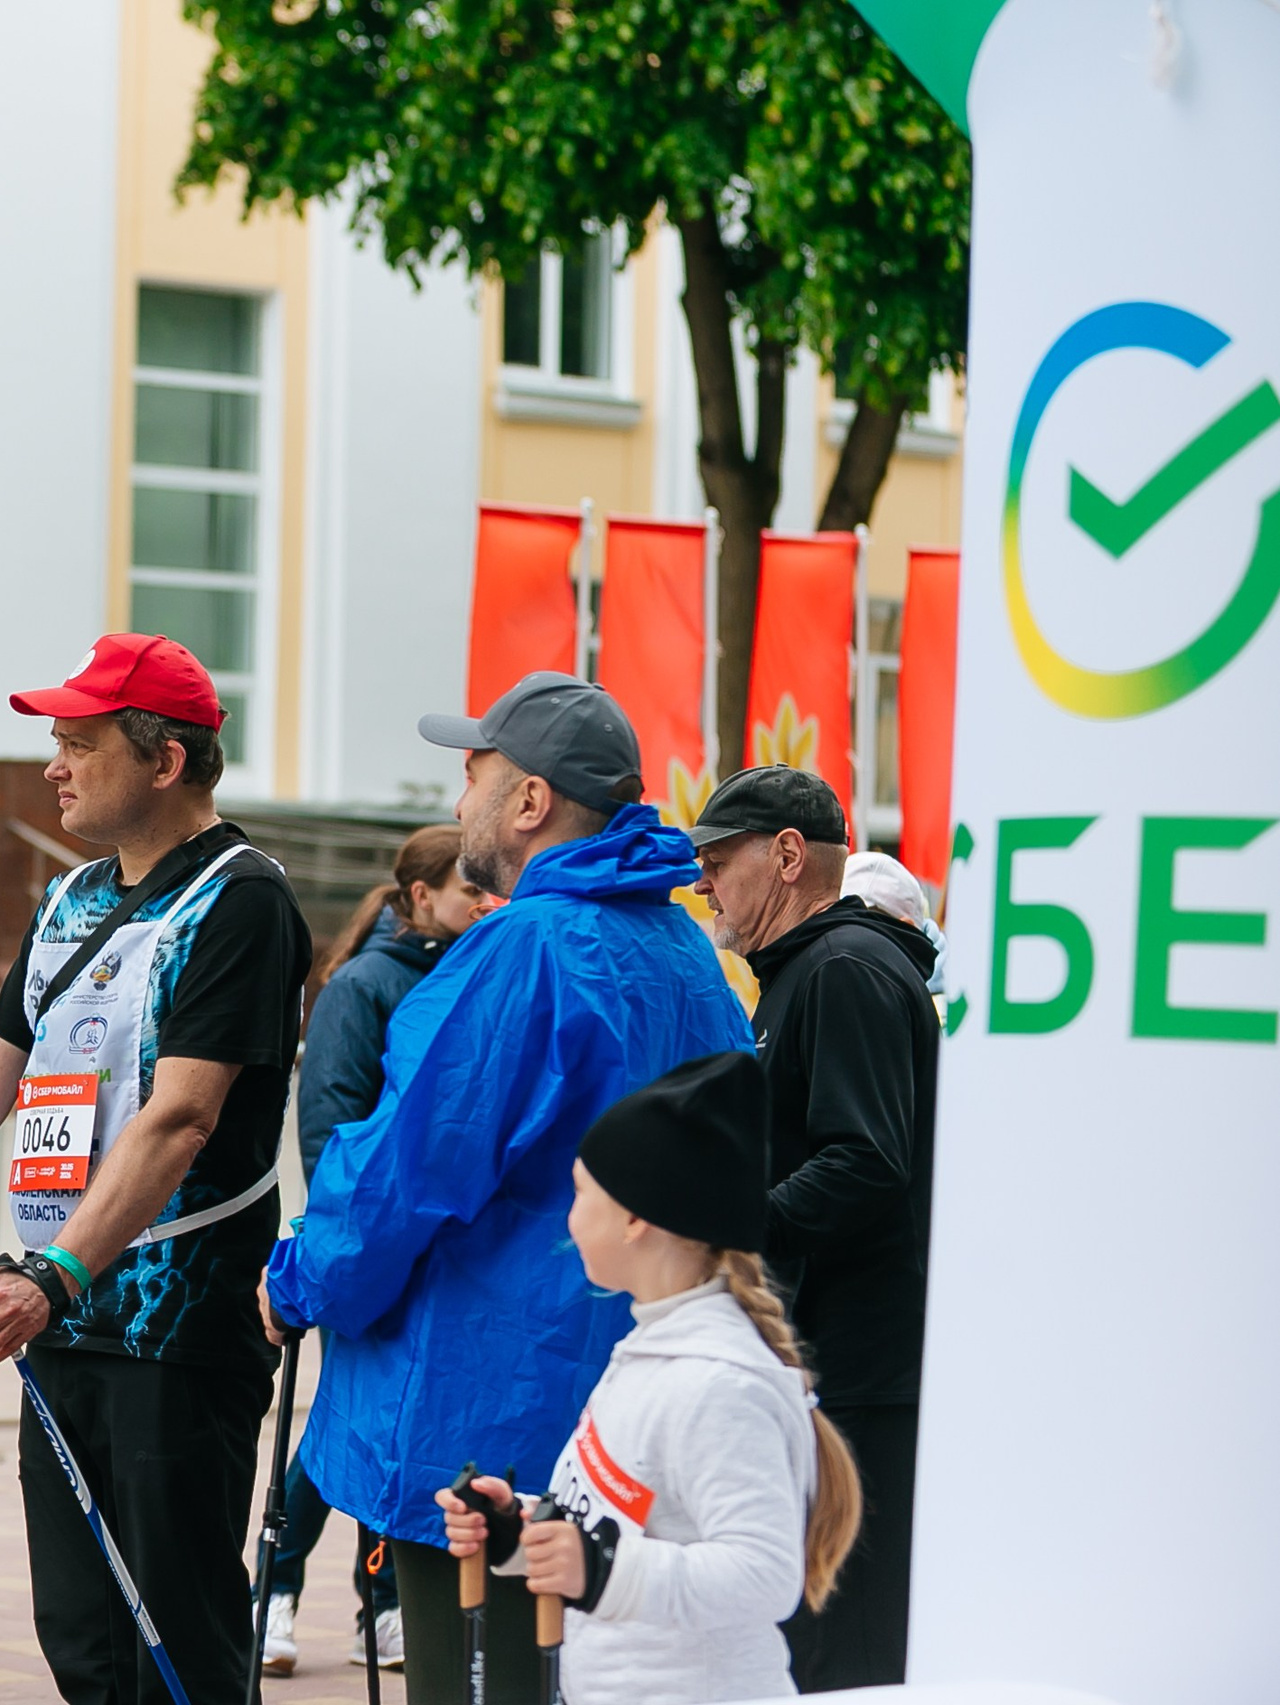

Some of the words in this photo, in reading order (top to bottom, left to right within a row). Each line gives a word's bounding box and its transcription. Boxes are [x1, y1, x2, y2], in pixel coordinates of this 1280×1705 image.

[947, 815, 1280, 1045] БЕ
[51, 1084, 84, 1096] МОБАЙЛ
[22, 1115, 70, 1154] 0046
[18, 1203, 67, 1222] ОБЛАСТЬ
